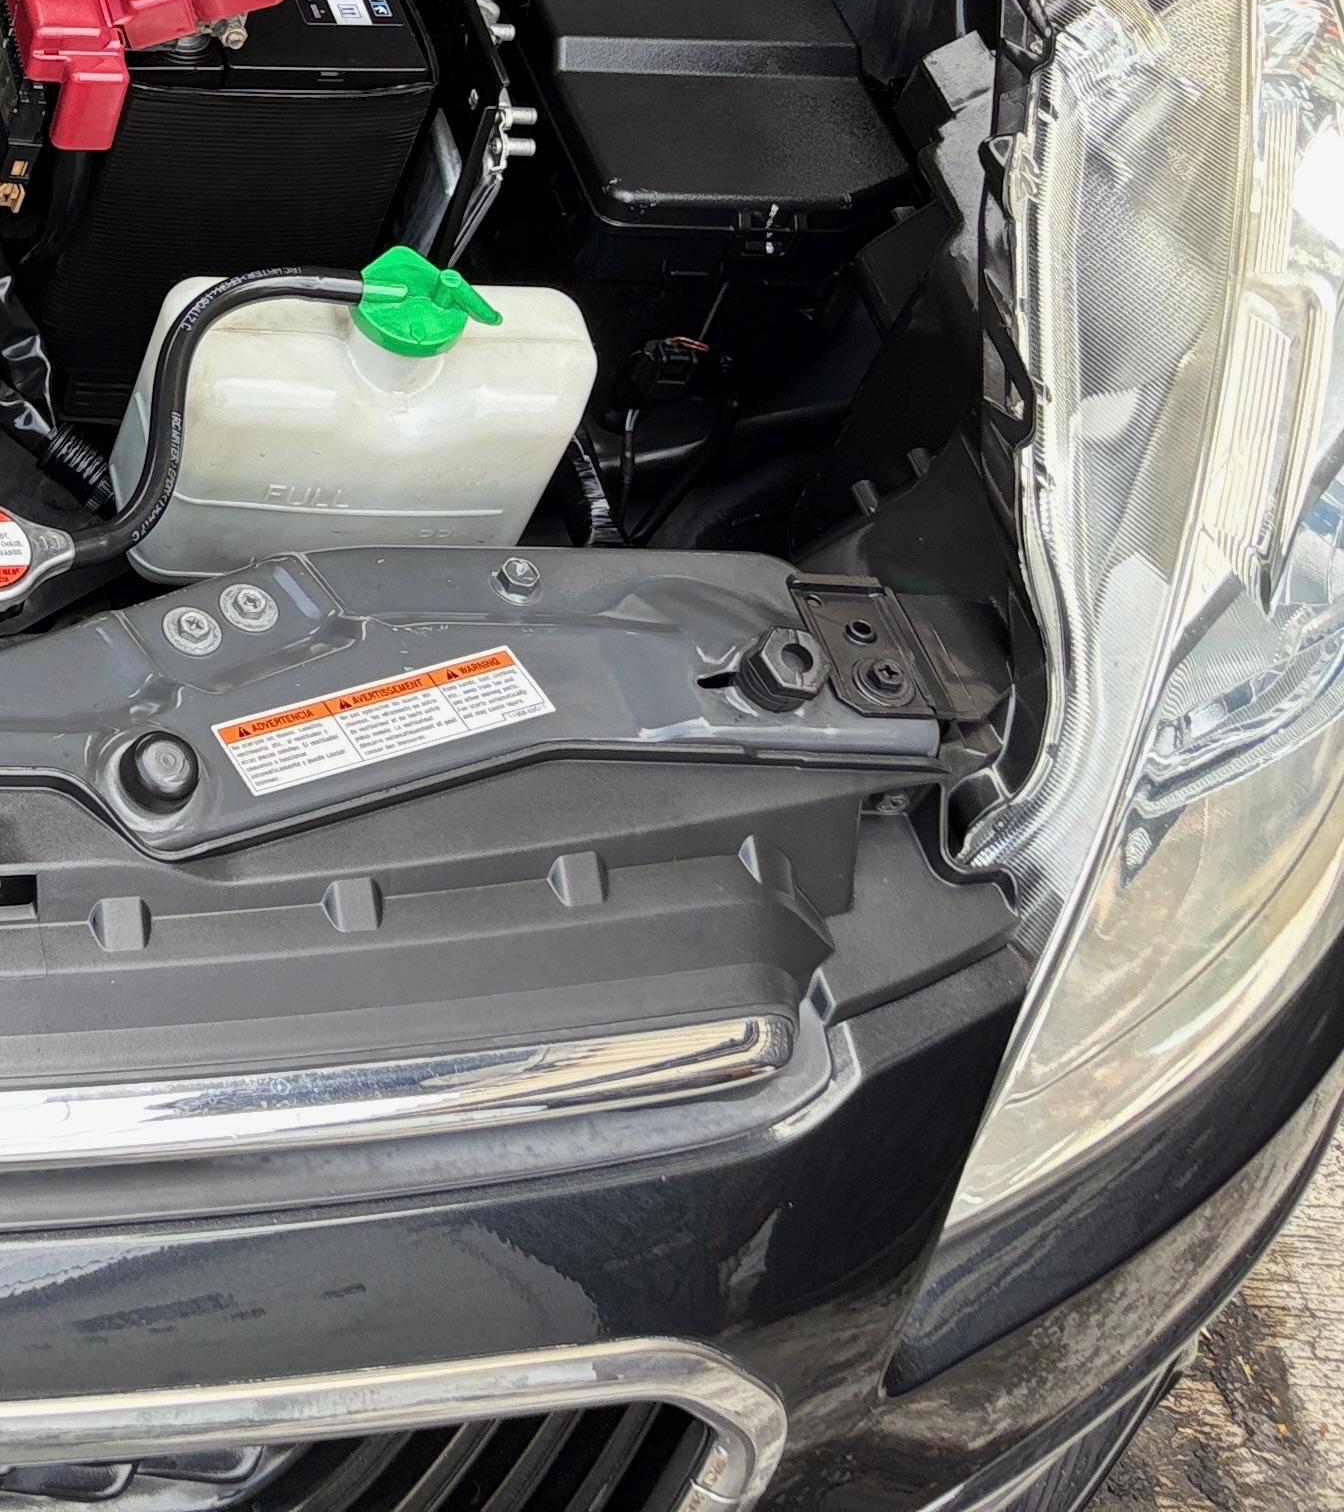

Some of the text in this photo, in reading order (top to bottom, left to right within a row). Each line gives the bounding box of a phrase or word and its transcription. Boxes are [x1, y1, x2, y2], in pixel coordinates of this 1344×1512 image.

[264, 483, 349, 508] FULL
[457, 656, 501, 675] WARNING
[349, 678, 424, 705] AVERTISSEMENT
[250, 708, 314, 732] ADVERTENCIA
